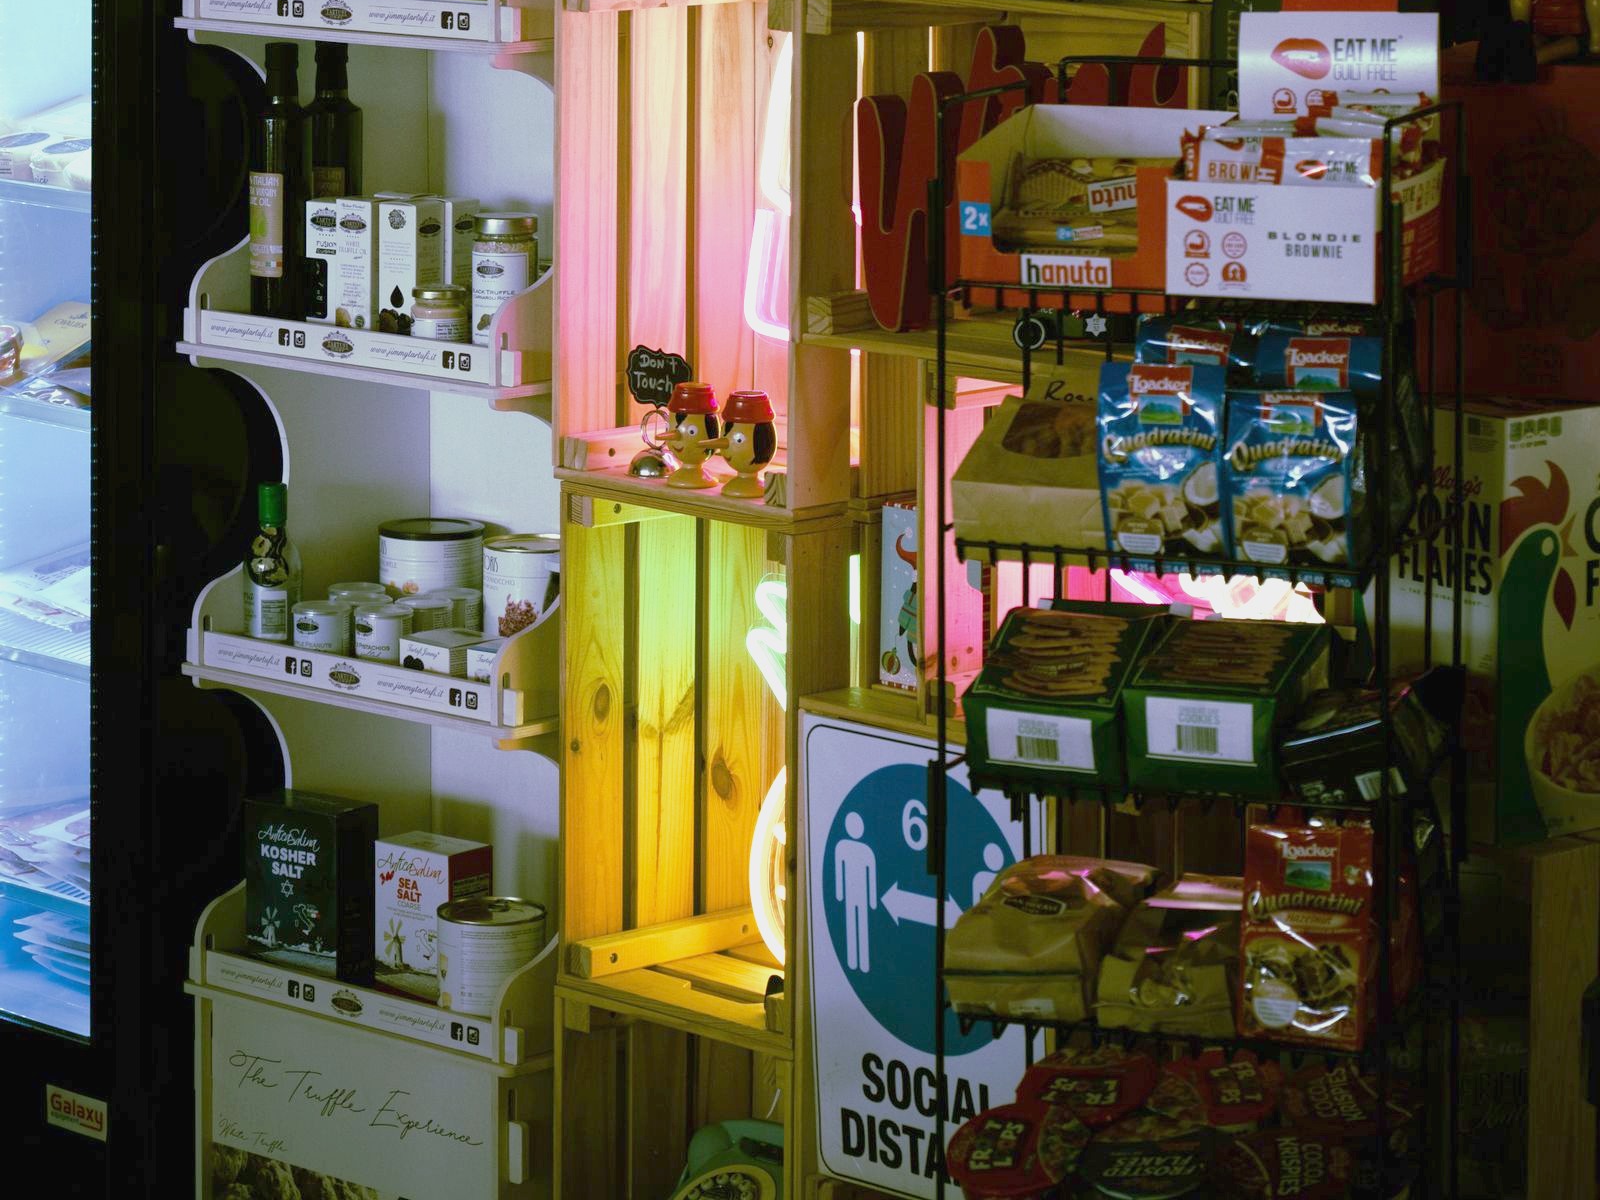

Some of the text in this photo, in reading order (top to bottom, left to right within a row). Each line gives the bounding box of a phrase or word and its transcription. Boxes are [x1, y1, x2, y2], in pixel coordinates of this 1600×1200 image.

[1333, 38, 1398, 61] EAT ME
[1333, 64, 1398, 81] GUILT FREE
[1214, 196, 1255, 212] EAT ME
[963, 206, 988, 231] 2x
[1267, 232, 1362, 243] BLONDIE
[1285, 244, 1343, 259] BROWNIE
[1027, 259, 1108, 285] hanuta
[1284, 347, 1347, 367] Loacker
[1126, 373, 1190, 394] Loacker
[902, 799, 929, 851] 6
[260, 843, 317, 866] KOSHER
[271, 861, 304, 879] SALT
[396, 888, 422, 903] SALT
[398, 877, 419, 892] SEA
[1246, 891, 1365, 921] Quadratini
[229, 1050, 484, 1146] The Truffle Experience
[50, 1092, 104, 1132] Galaxy
[1275, 1135, 1301, 1196] KRISPIES
[1300, 1142, 1325, 1187] COCOA
